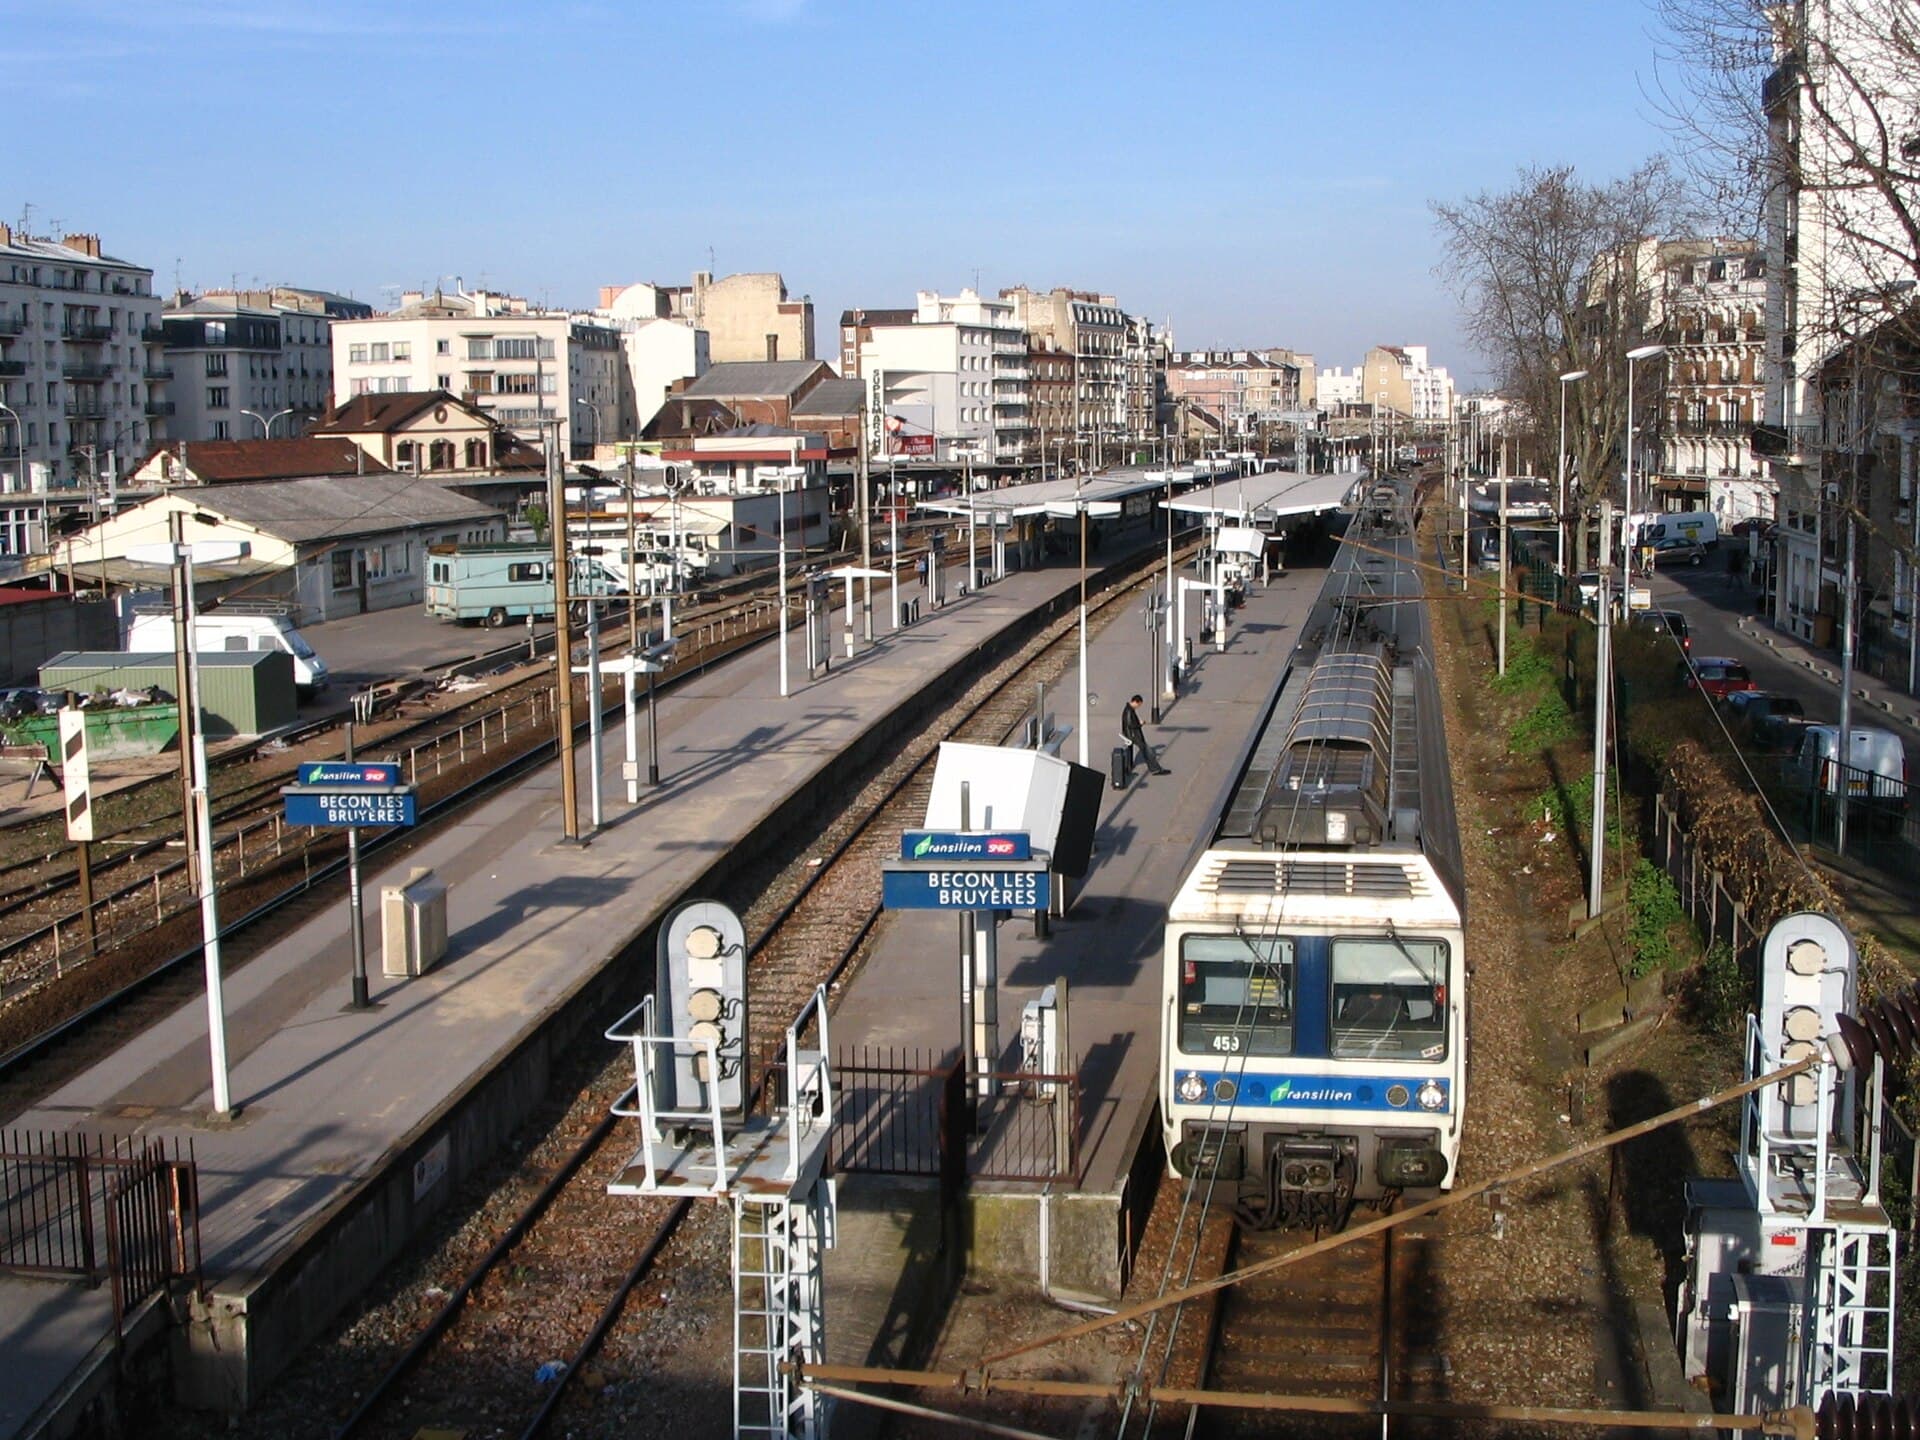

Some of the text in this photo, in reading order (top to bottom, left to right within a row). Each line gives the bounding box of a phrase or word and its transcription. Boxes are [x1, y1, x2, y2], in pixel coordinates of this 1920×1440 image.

[872, 369, 881, 453] SUPERMARCH
[378, 795, 403, 808] LES
[328, 807, 404, 822] BRUYÈRES
[987, 843, 1014, 854] SNCF
[1004, 872, 1036, 888] LES
[939, 887, 1036, 905] BRUYÈRES
[1213, 1036, 1239, 1052] 459
[1274, 1086, 1353, 1102] Transilien
